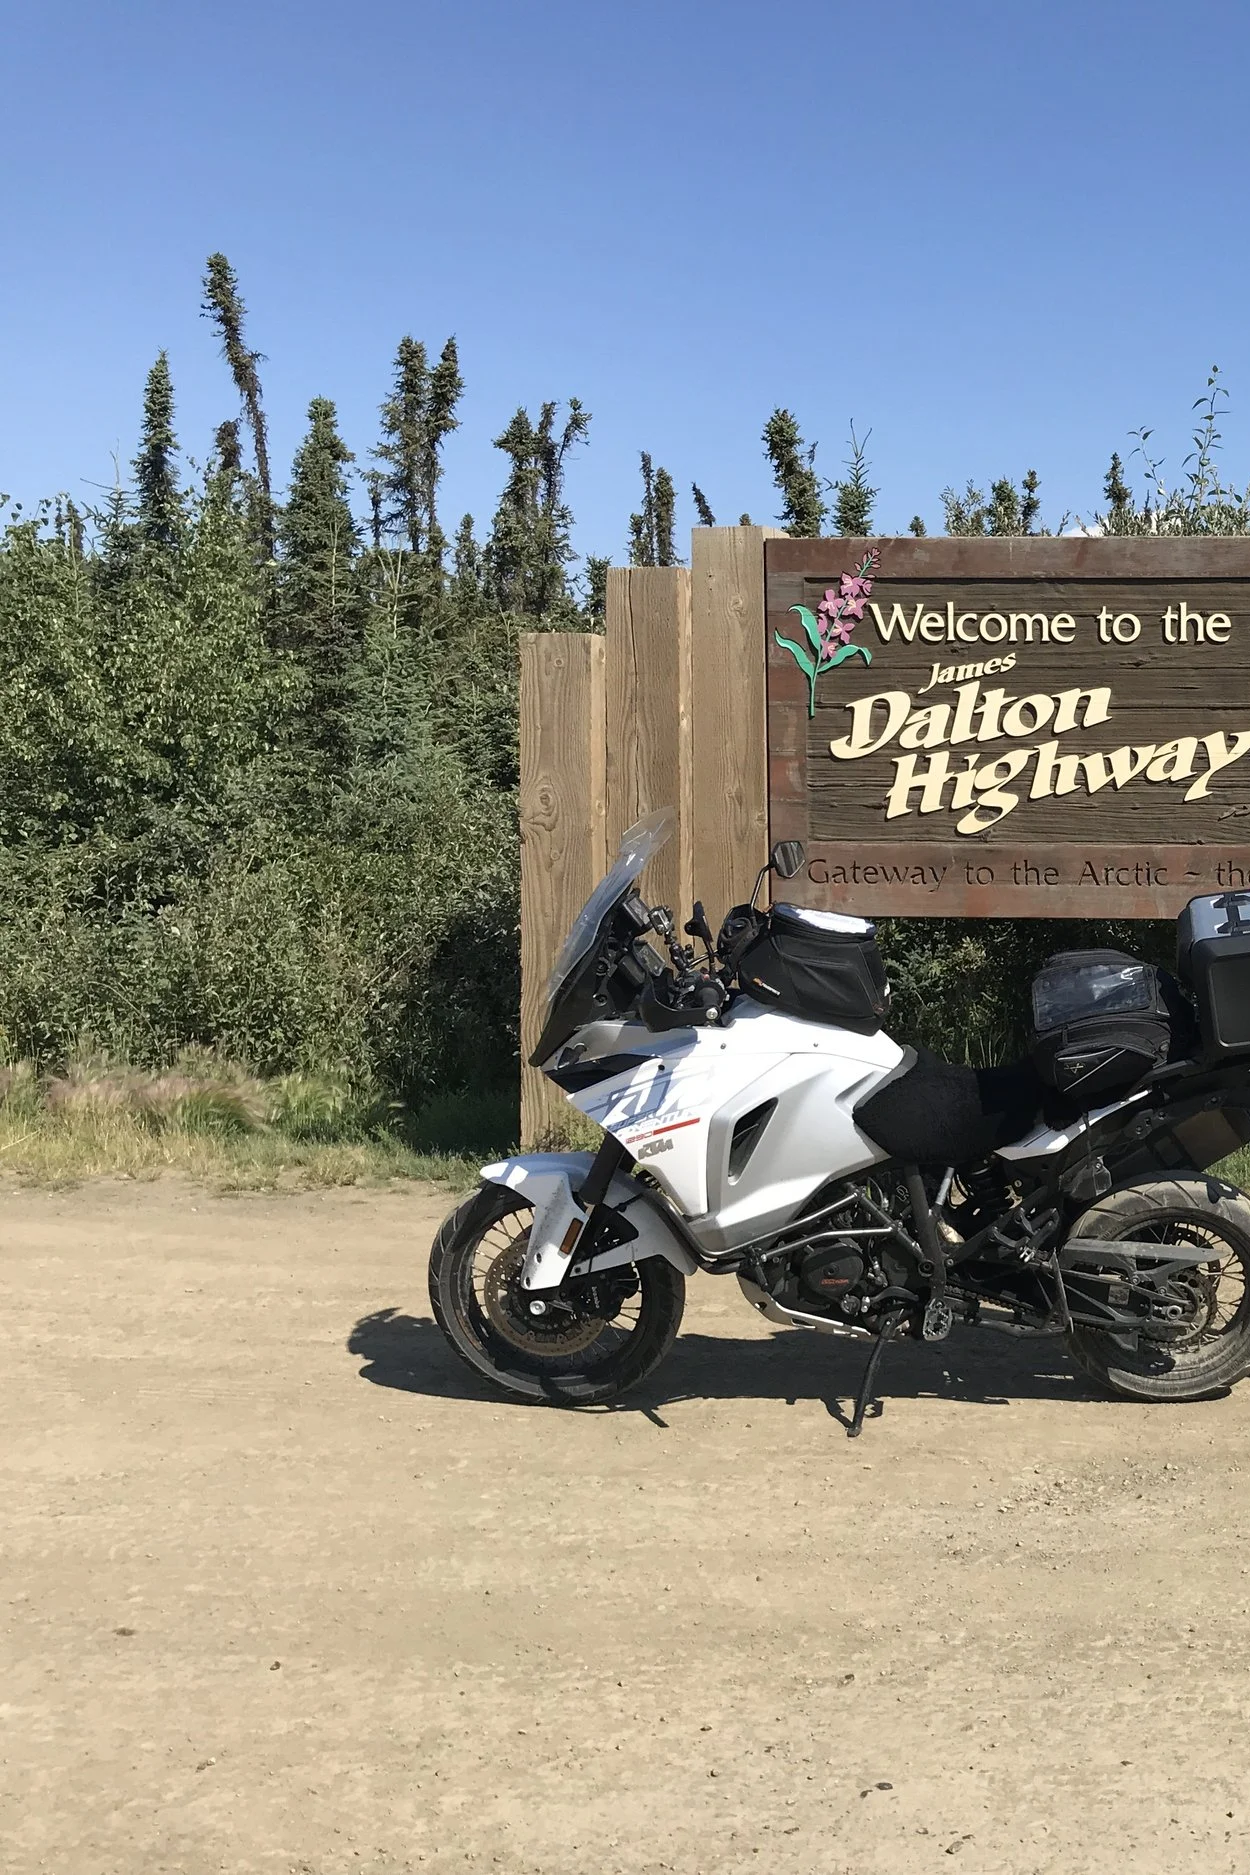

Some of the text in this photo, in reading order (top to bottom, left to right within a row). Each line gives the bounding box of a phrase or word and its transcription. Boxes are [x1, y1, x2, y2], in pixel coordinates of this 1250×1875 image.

[869, 602, 1232, 643] Welcome to the
[917, 652, 1017, 695] James
[830, 681, 1113, 759] Dalton
[807, 859, 947, 893] Gateway
[964, 860, 995, 886] to
[1011, 859, 1060, 886] the
[1078, 860, 1168, 886] Arctic
[638, 1138, 674, 1160] KTM
